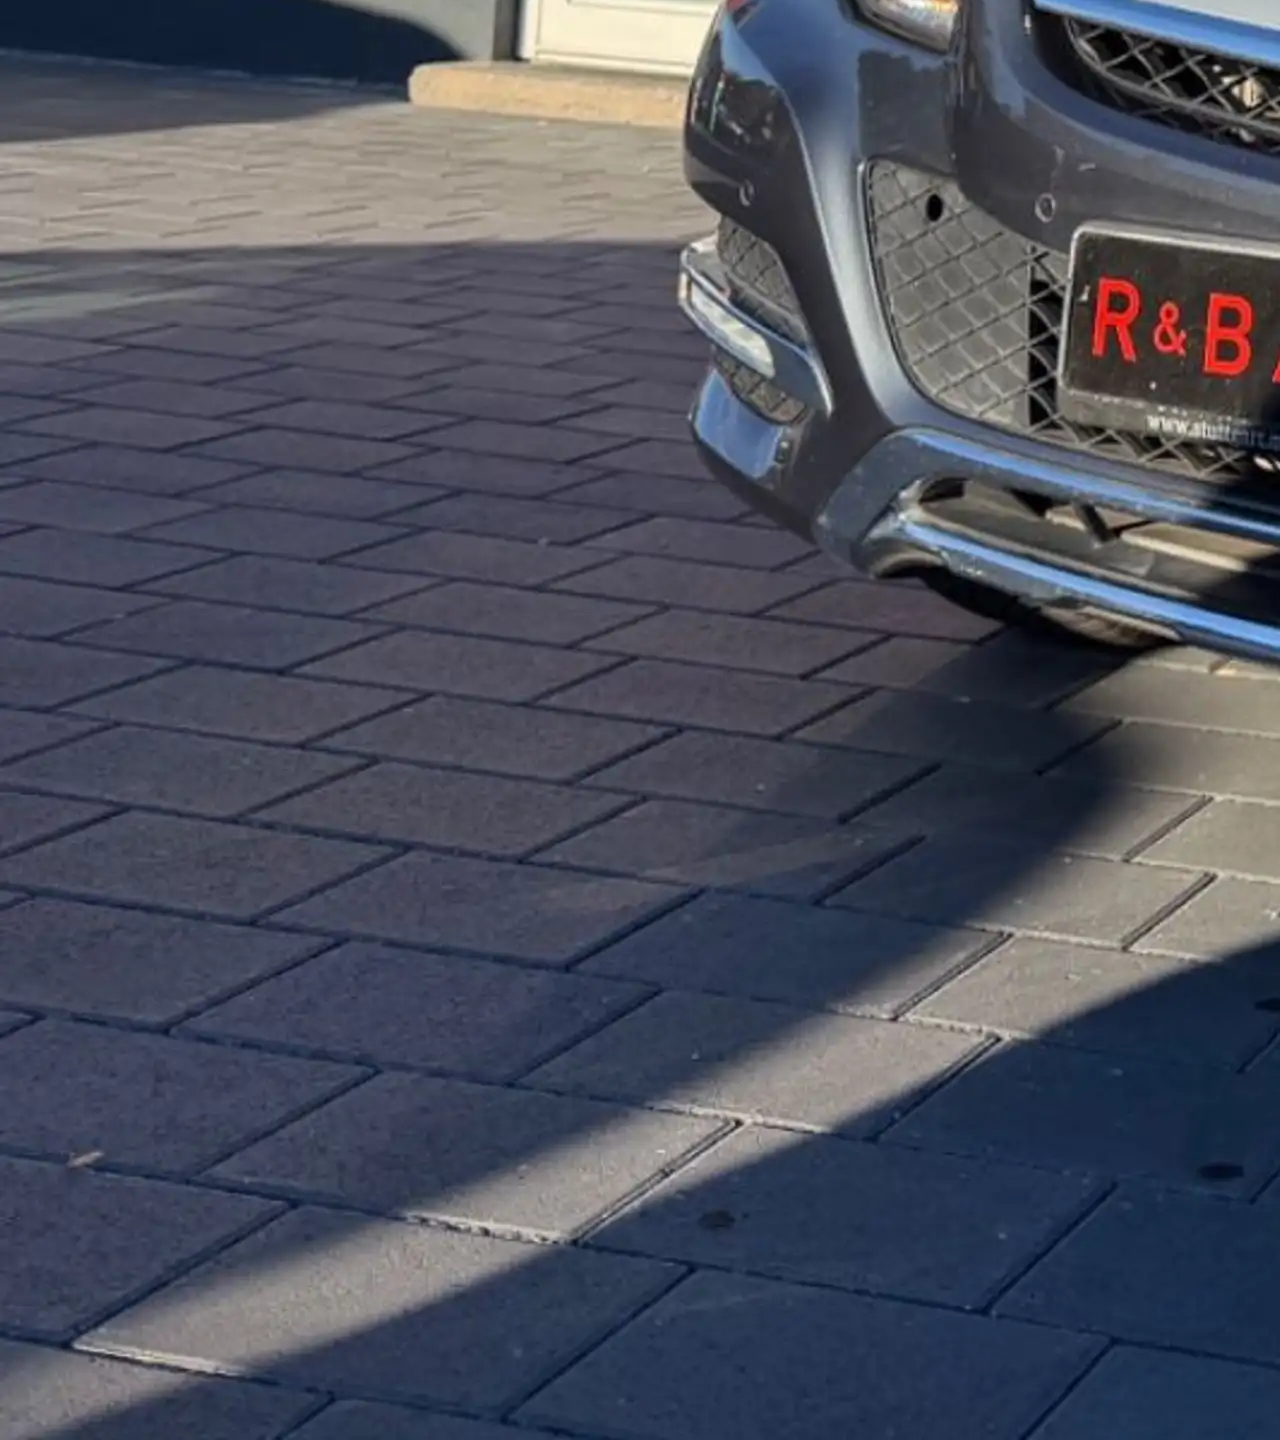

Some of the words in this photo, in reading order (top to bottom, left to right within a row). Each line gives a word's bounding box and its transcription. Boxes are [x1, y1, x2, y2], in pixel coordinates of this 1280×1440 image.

[1092, 276, 1141, 363] R
[1153, 300, 1187, 356] &
[1203, 291, 1254, 377] B
